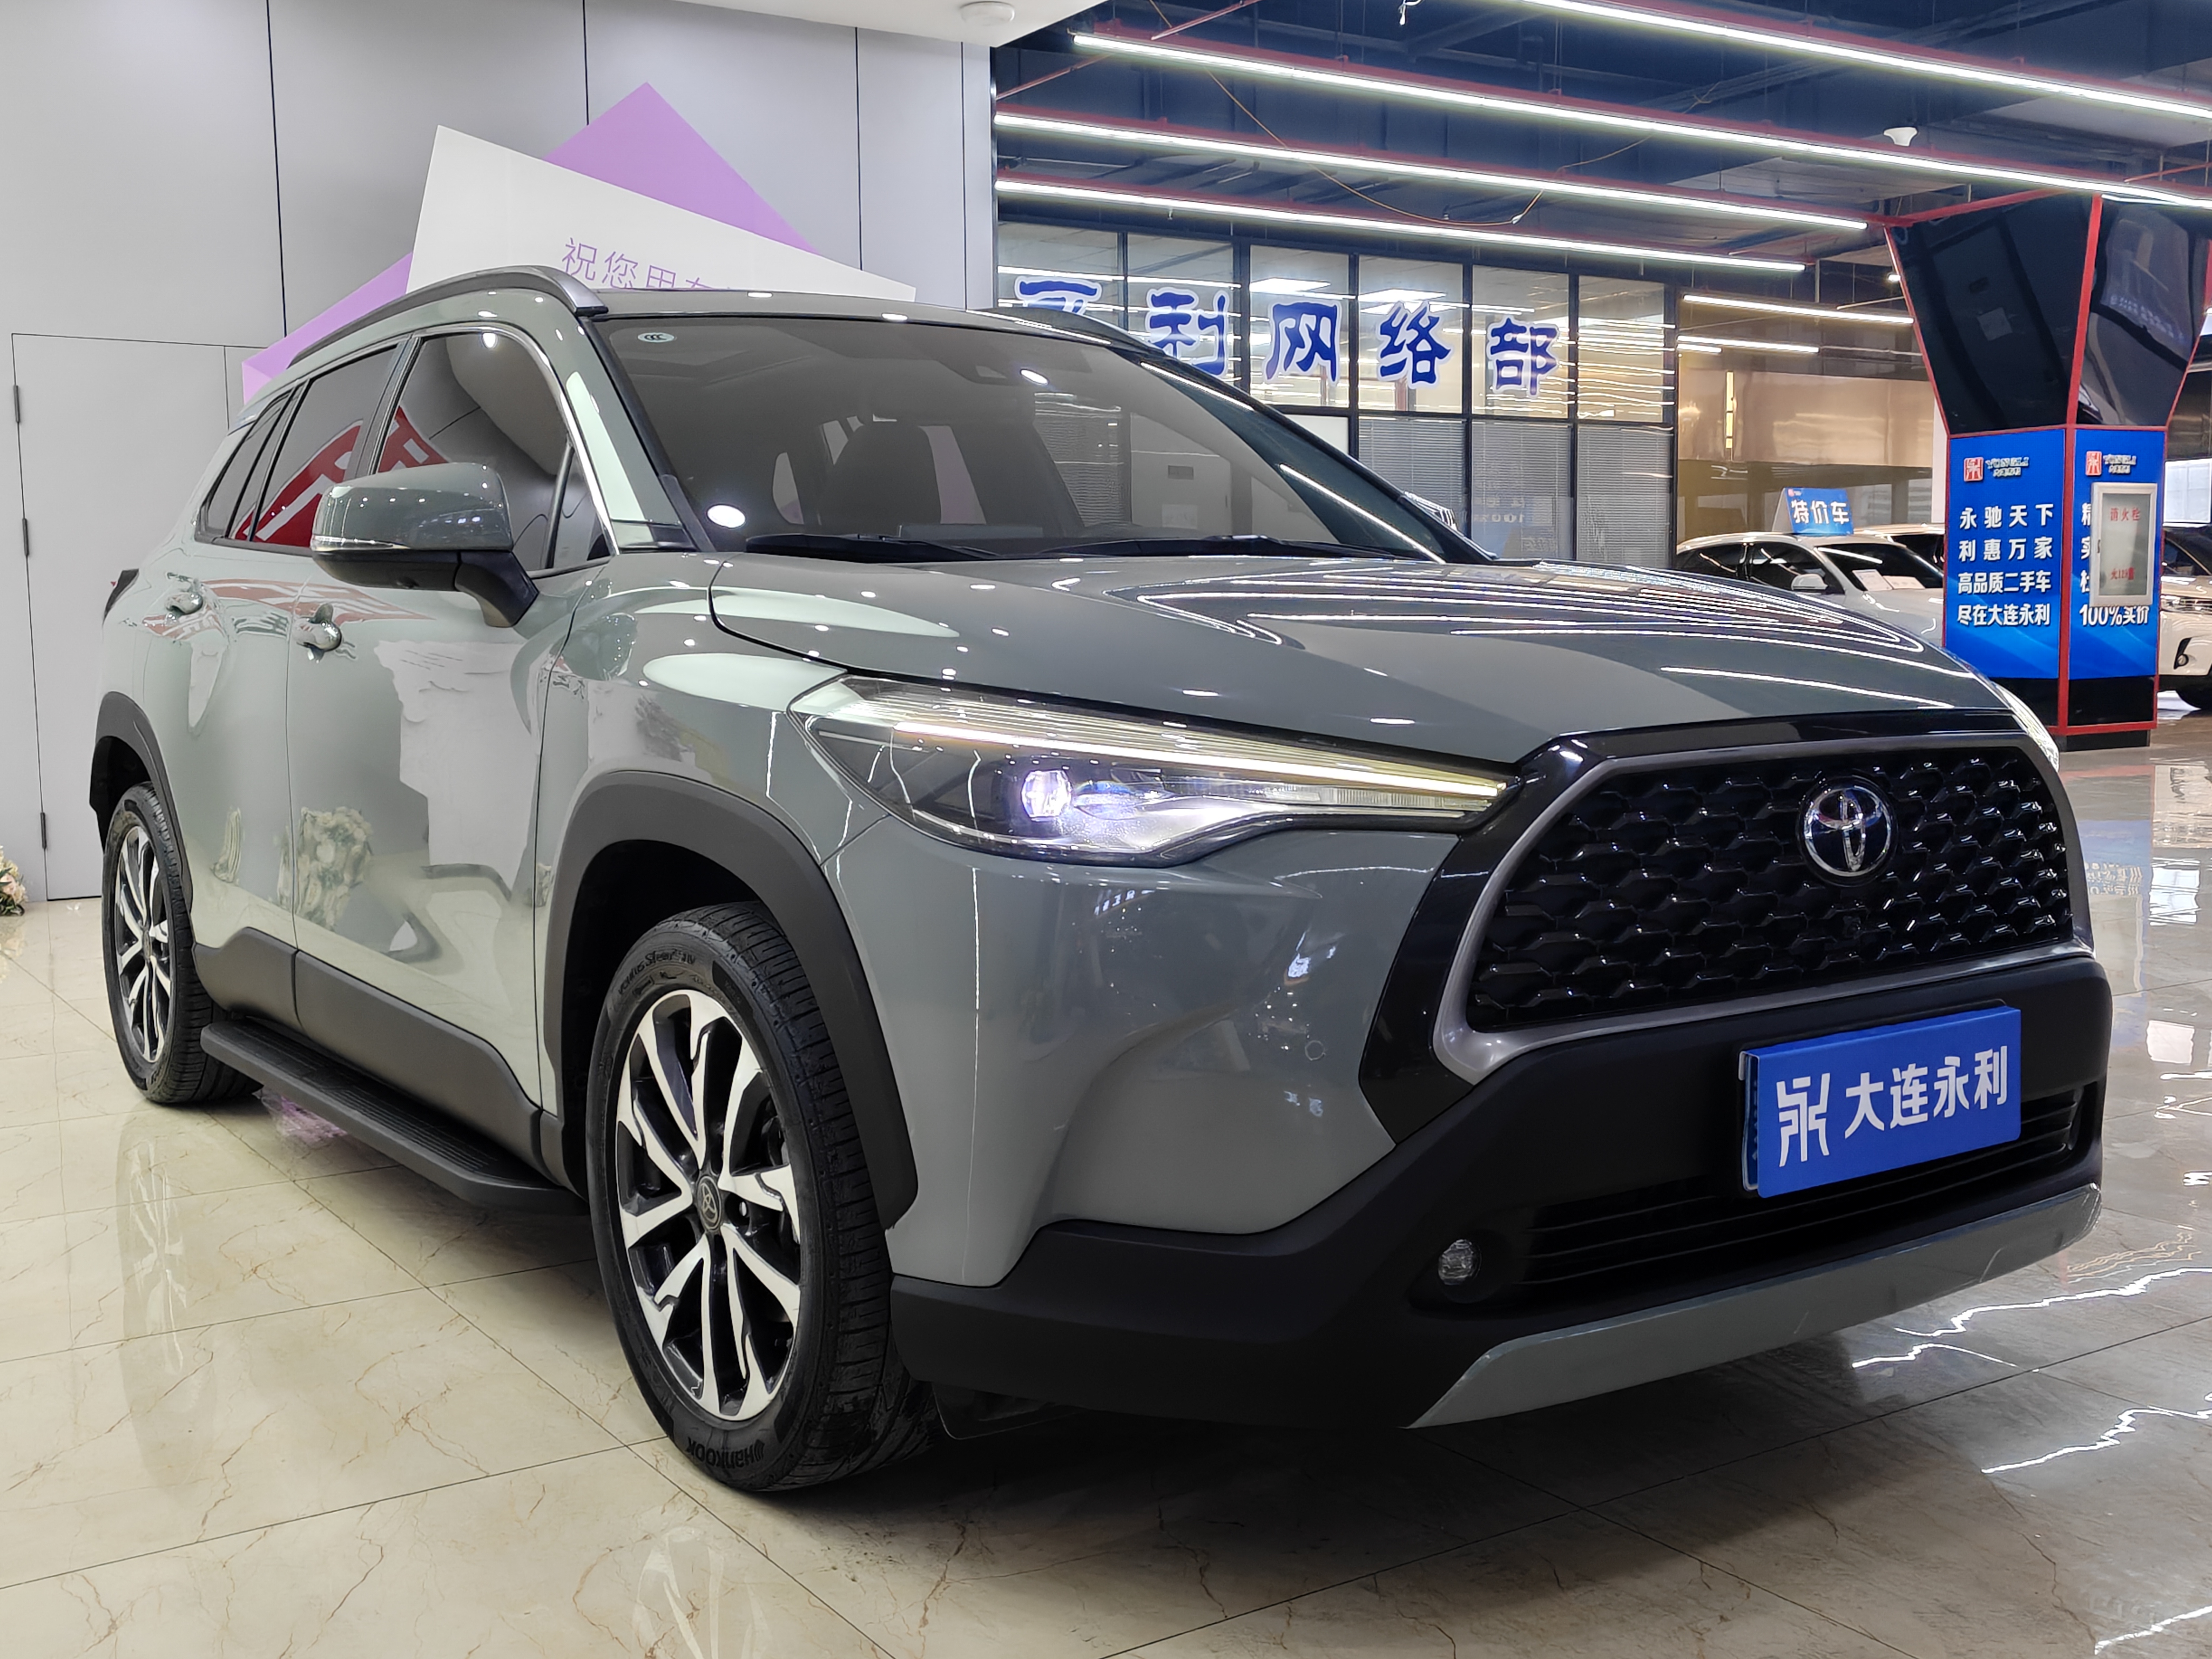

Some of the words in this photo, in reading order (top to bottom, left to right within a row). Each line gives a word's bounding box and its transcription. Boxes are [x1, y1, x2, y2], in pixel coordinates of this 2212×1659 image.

[1791, 500, 1850, 524] 特价车
[1959, 503, 2054, 530] 永驰天下
[1958, 536, 2053, 562] 利惠万家
[1958, 570, 2052, 594] 高品质二手车
[1957, 603, 2051, 626] 尽在大连永利
[1845, 1046, 2007, 1139] 大连永利
